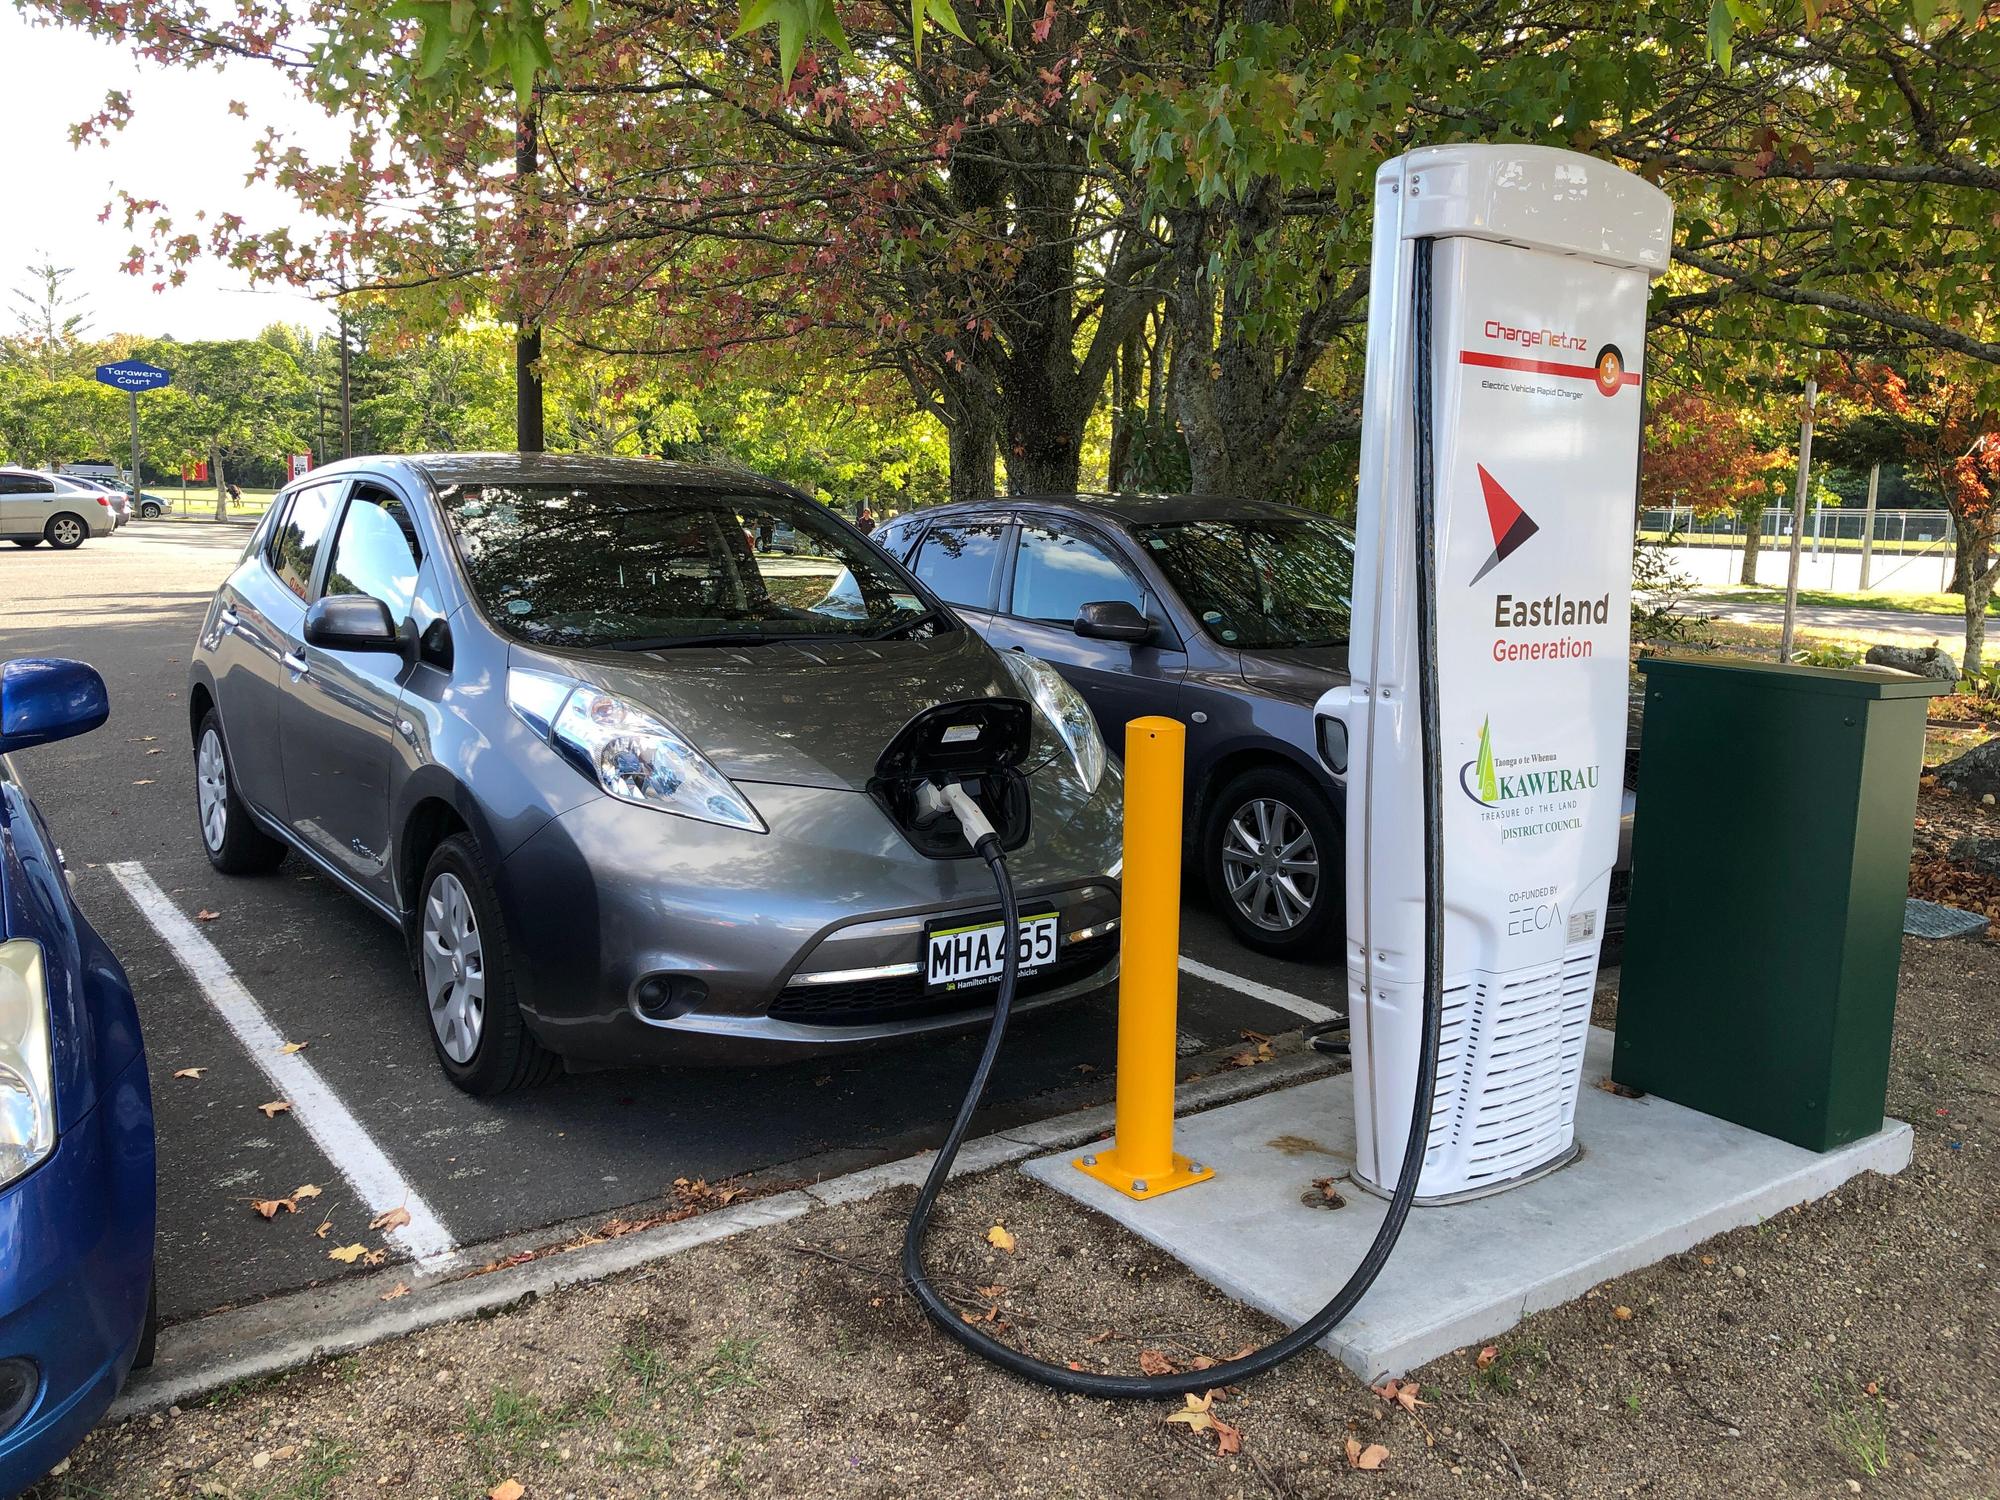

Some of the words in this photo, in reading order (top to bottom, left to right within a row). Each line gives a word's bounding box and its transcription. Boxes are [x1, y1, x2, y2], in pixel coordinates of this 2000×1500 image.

[105, 367, 162, 378] Tarawera
[117, 377, 151, 386] Court
[1481, 380, 1509, 391] Electric
[1510, 383, 1536, 394] Vehicle
[1537, 386, 1556, 396] Rapid
[1557, 389, 1584, 400] Charger
[1494, 592, 1610, 628] Eastland
[1493, 636, 1593, 662] Generation
[1494, 758, 1517, 768] Taonga
[1518, 757, 1523, 765] o
[1524, 756, 1530, 764] te
[1531, 753, 1557, 763] Whenua
[1500, 765, 1600, 800] KAWERAU
[1481, 807, 1520, 822] TREASURE
[1524, 805, 1534, 815] OF
[1539, 803, 1554, 813] THE
[1558, 800, 1578, 810] LAND
[1503, 822, 1544, 840] DISTRICT
[1545, 817, 1583, 833] COUNCIL
[1508, 887, 1548, 903] CO-FUNDED
[1549, 885, 1558, 896] BY
[1508, 902, 1562, 936] EECA
[957, 978, 987, 989] Hamilton
[1017, 968, 1038, 978] ehicles
